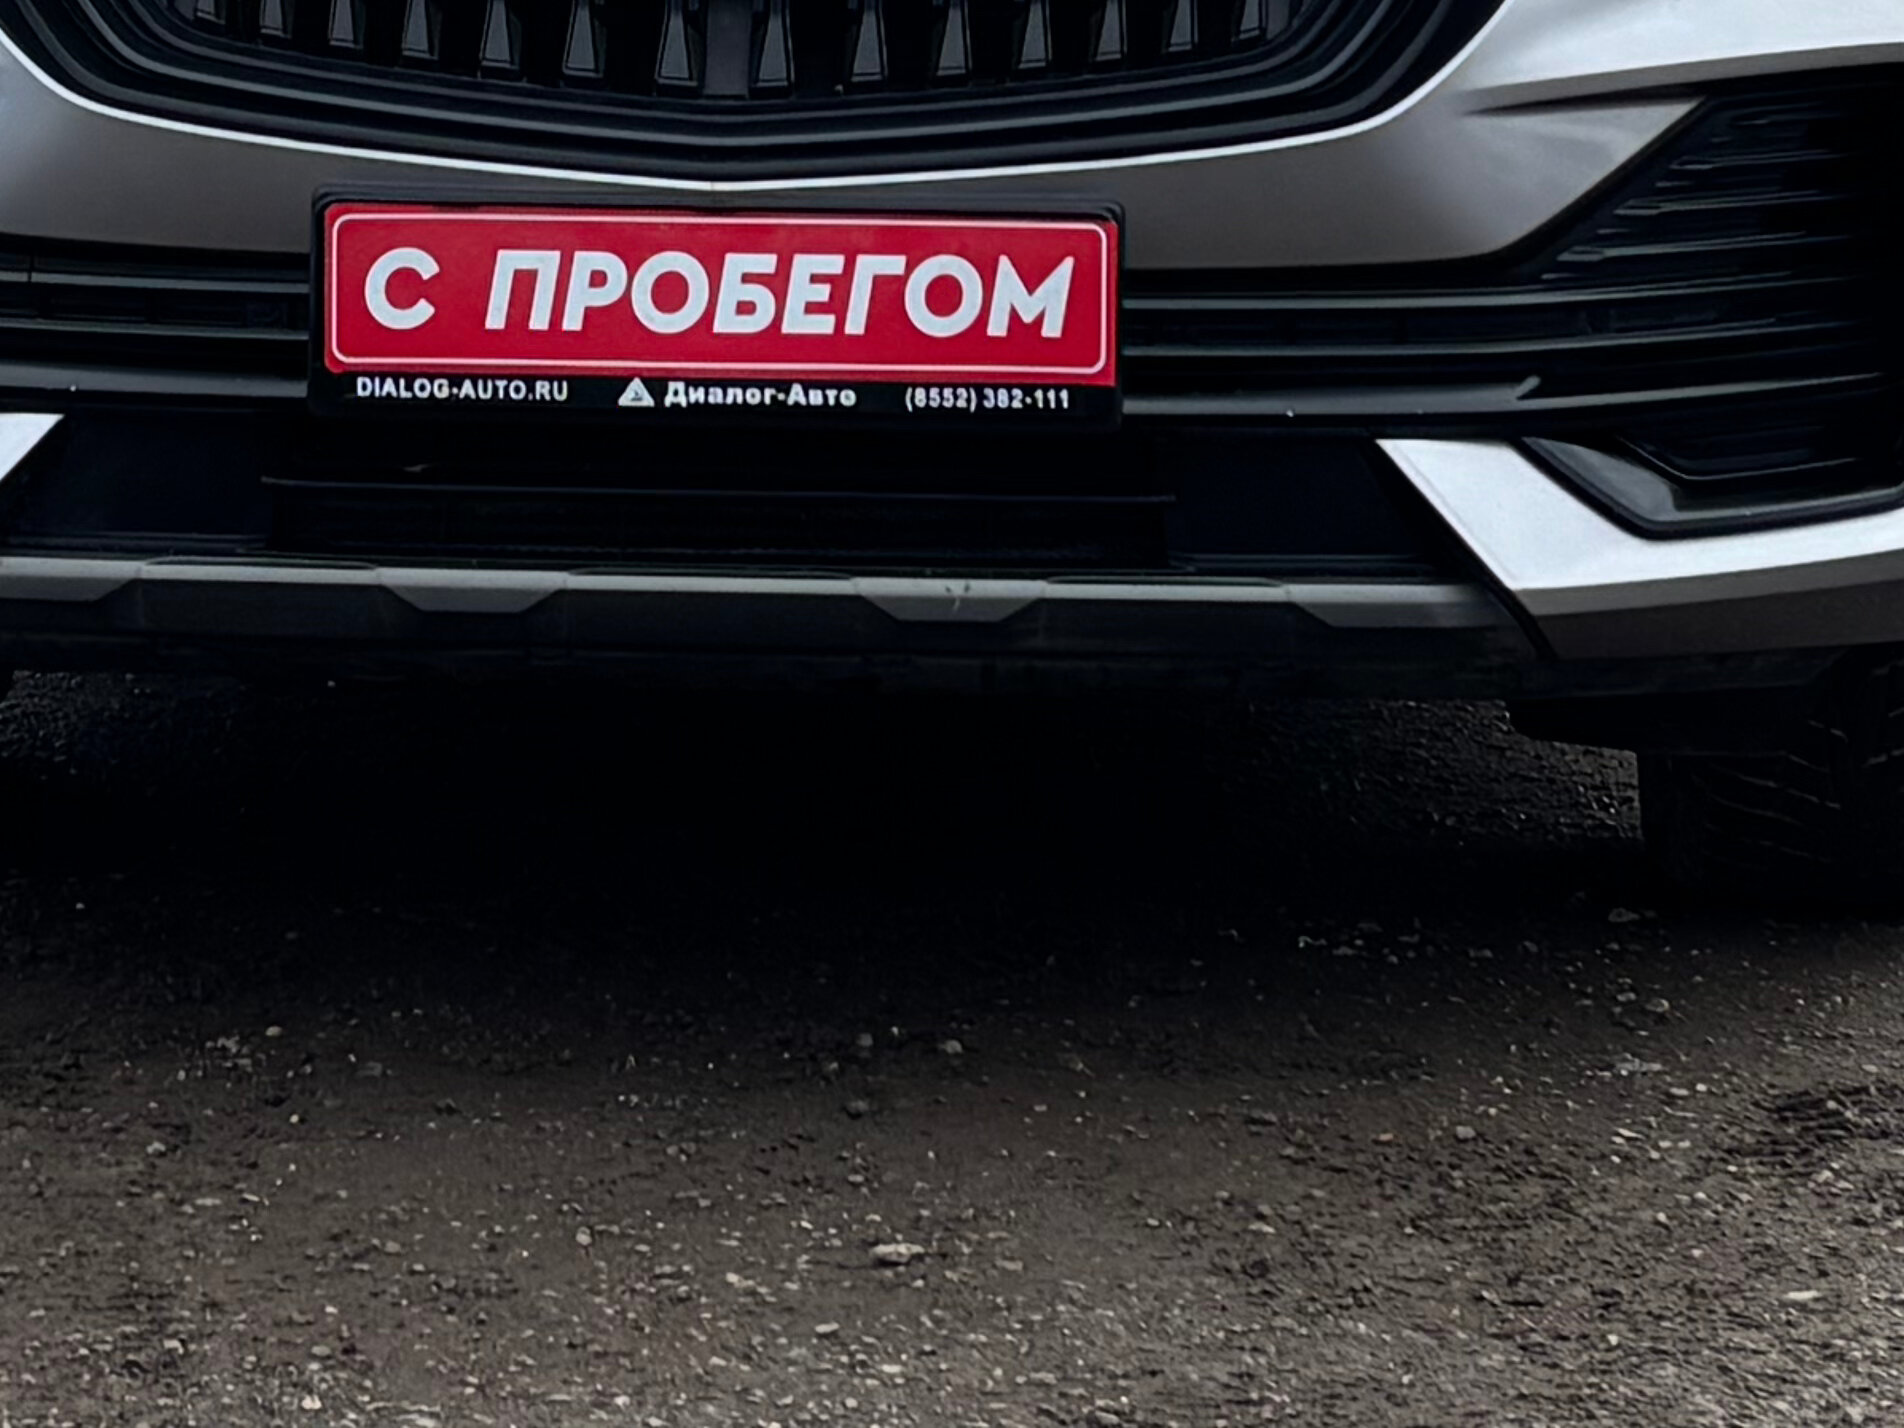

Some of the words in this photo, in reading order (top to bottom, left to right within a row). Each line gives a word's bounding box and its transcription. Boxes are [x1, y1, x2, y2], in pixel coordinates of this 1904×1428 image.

[364, 246, 441, 331] С
[483, 248, 1076, 339] ПРОБЕГОМ
[355, 375, 569, 403] DIALOG-AUTO.RU
[662, 379, 858, 409] Диалог-Авто
[904, 384, 978, 413] (8552)
[982, 385, 1071, 411] 382-111
